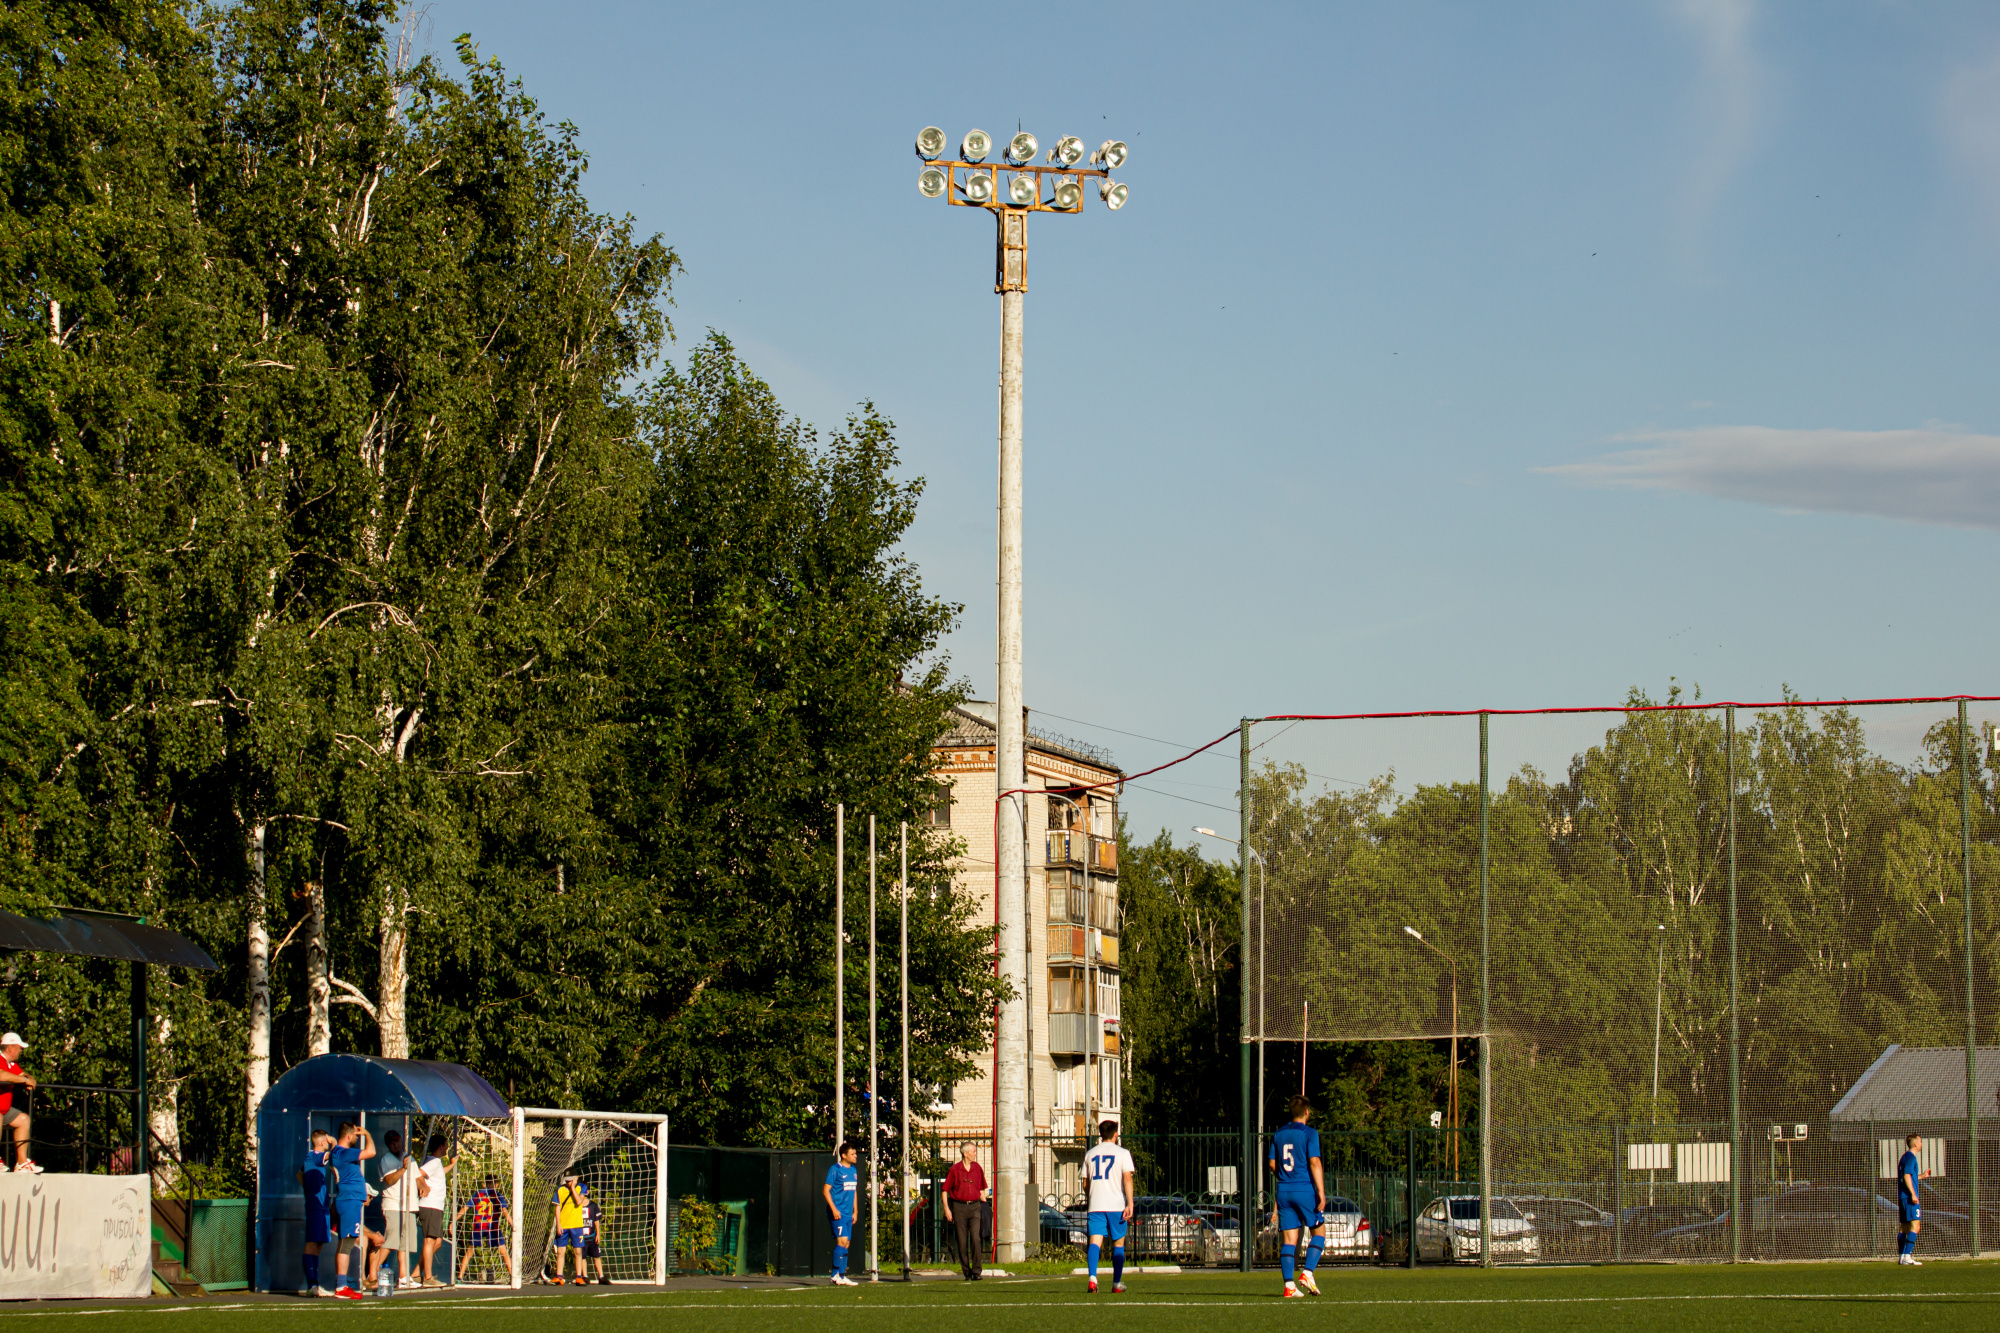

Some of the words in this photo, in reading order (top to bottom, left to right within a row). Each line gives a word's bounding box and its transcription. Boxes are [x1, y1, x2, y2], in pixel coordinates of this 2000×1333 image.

[1091, 1155, 1115, 1180] 17
[1283, 1143, 1295, 1172] 5
[477, 1200, 493, 1216] 21
[103, 1216, 135, 1240] ПРИБОЙ
[837, 1226, 843, 1236] 7
